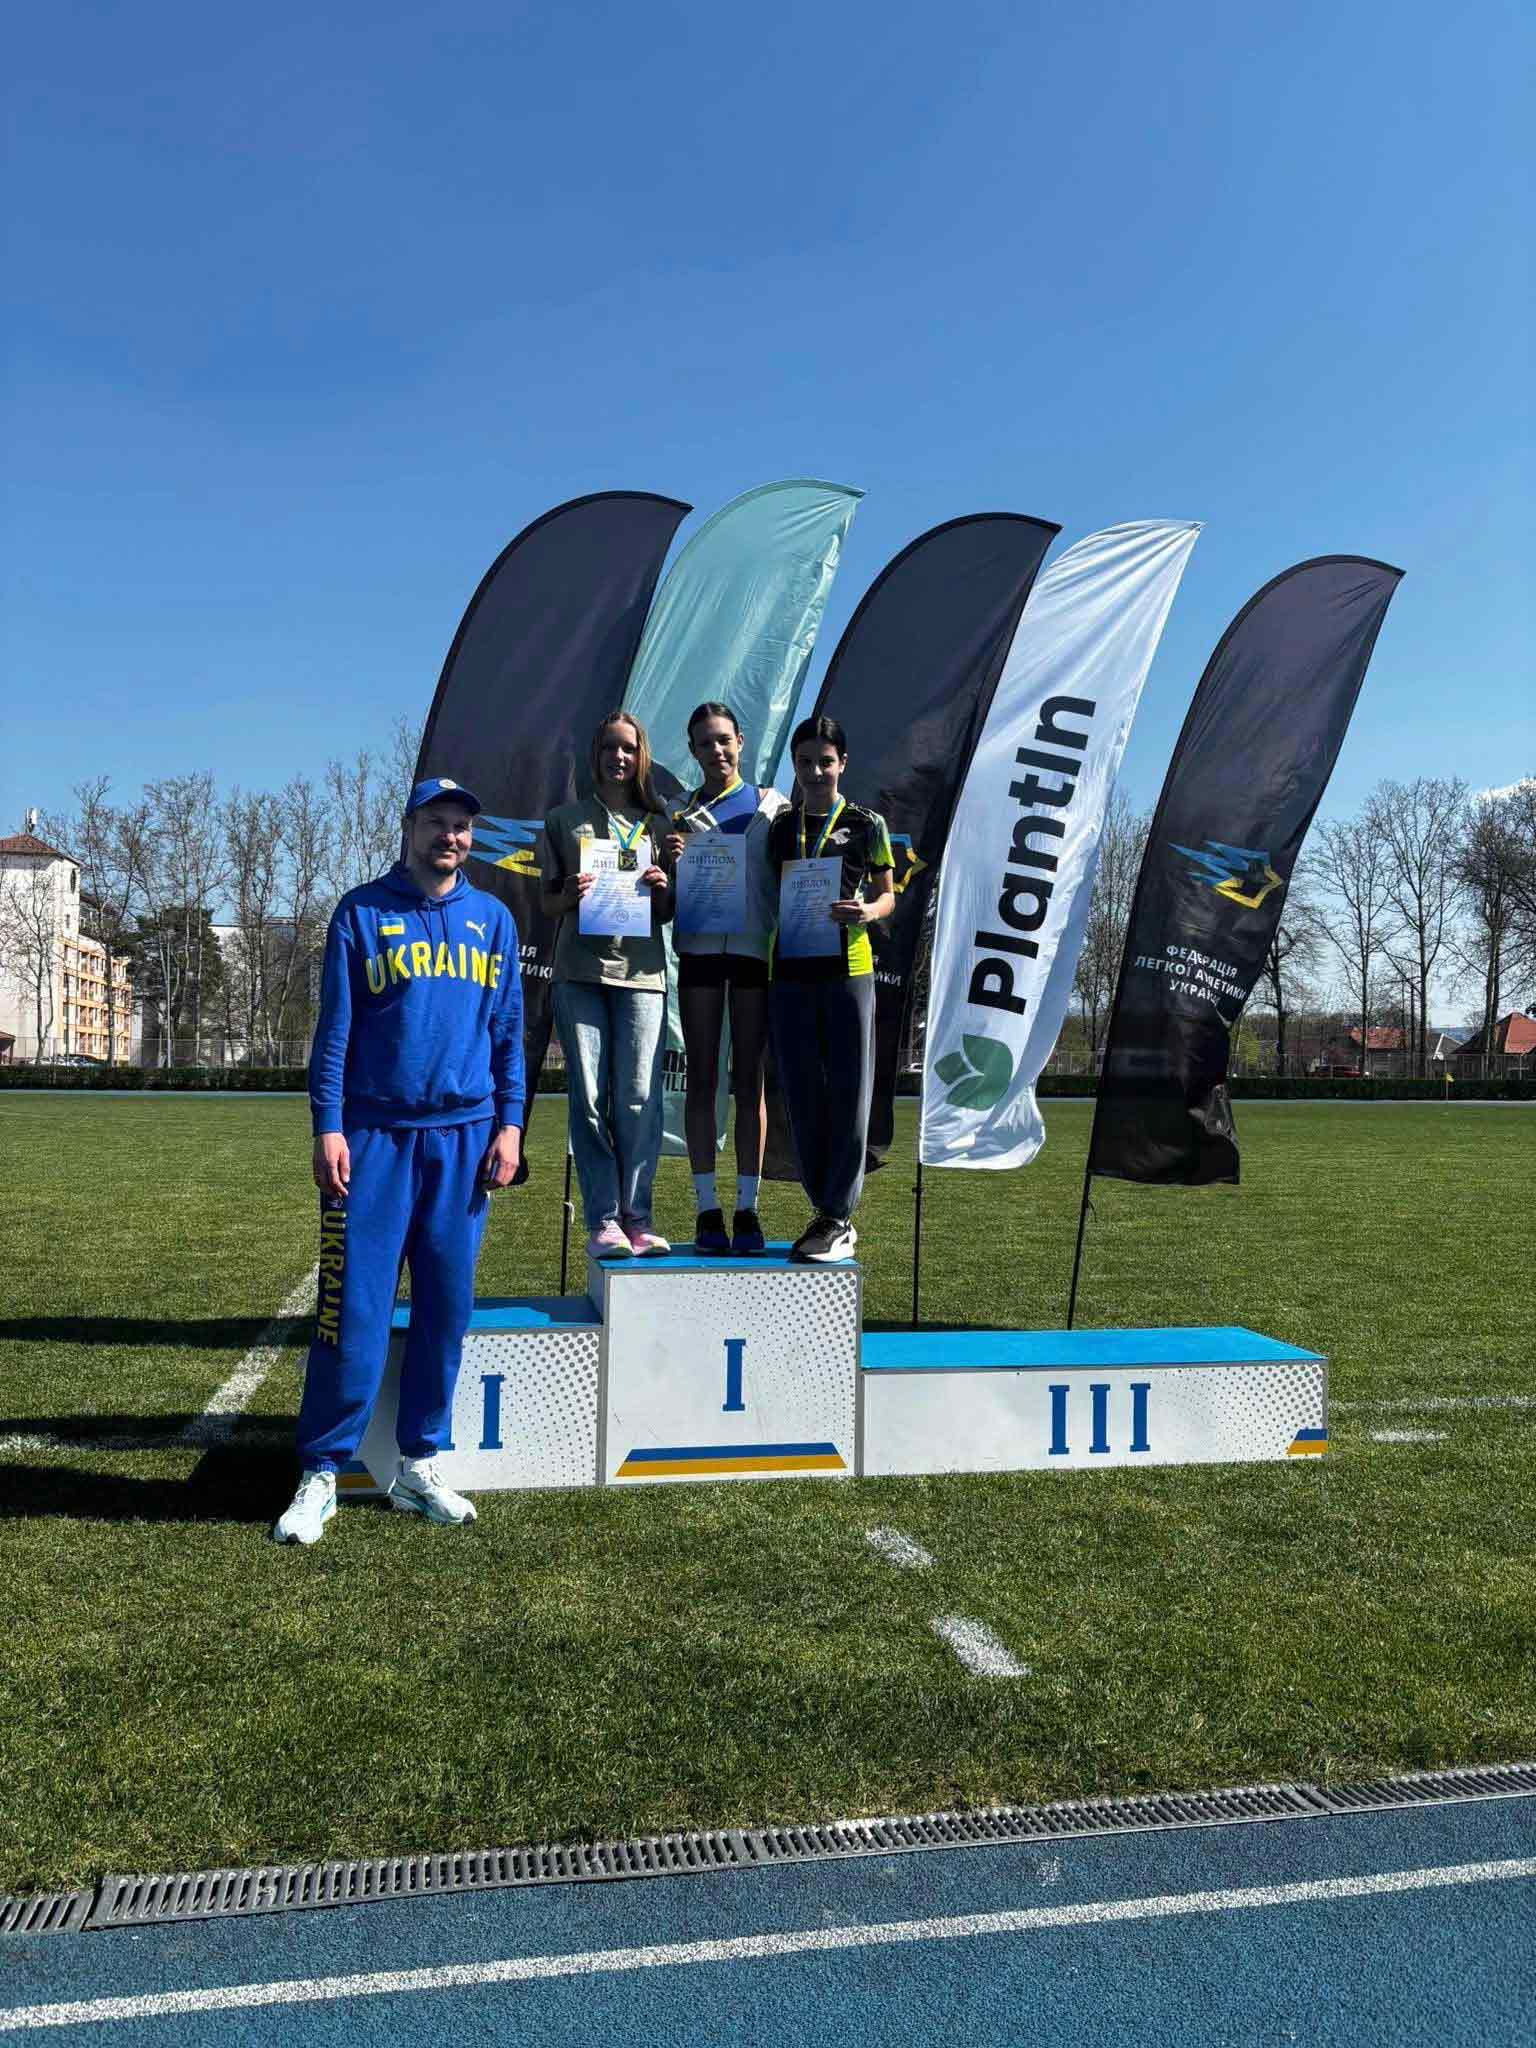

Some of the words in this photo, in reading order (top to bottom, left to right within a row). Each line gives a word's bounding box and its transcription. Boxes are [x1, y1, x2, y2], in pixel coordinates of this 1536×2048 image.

[366, 941, 502, 994] UKRAINE
[1135, 955, 1193, 977] ЛЕГКОЇ
[318, 1210, 347, 1345] UKRAINE
[1048, 1382, 1151, 1455] III
